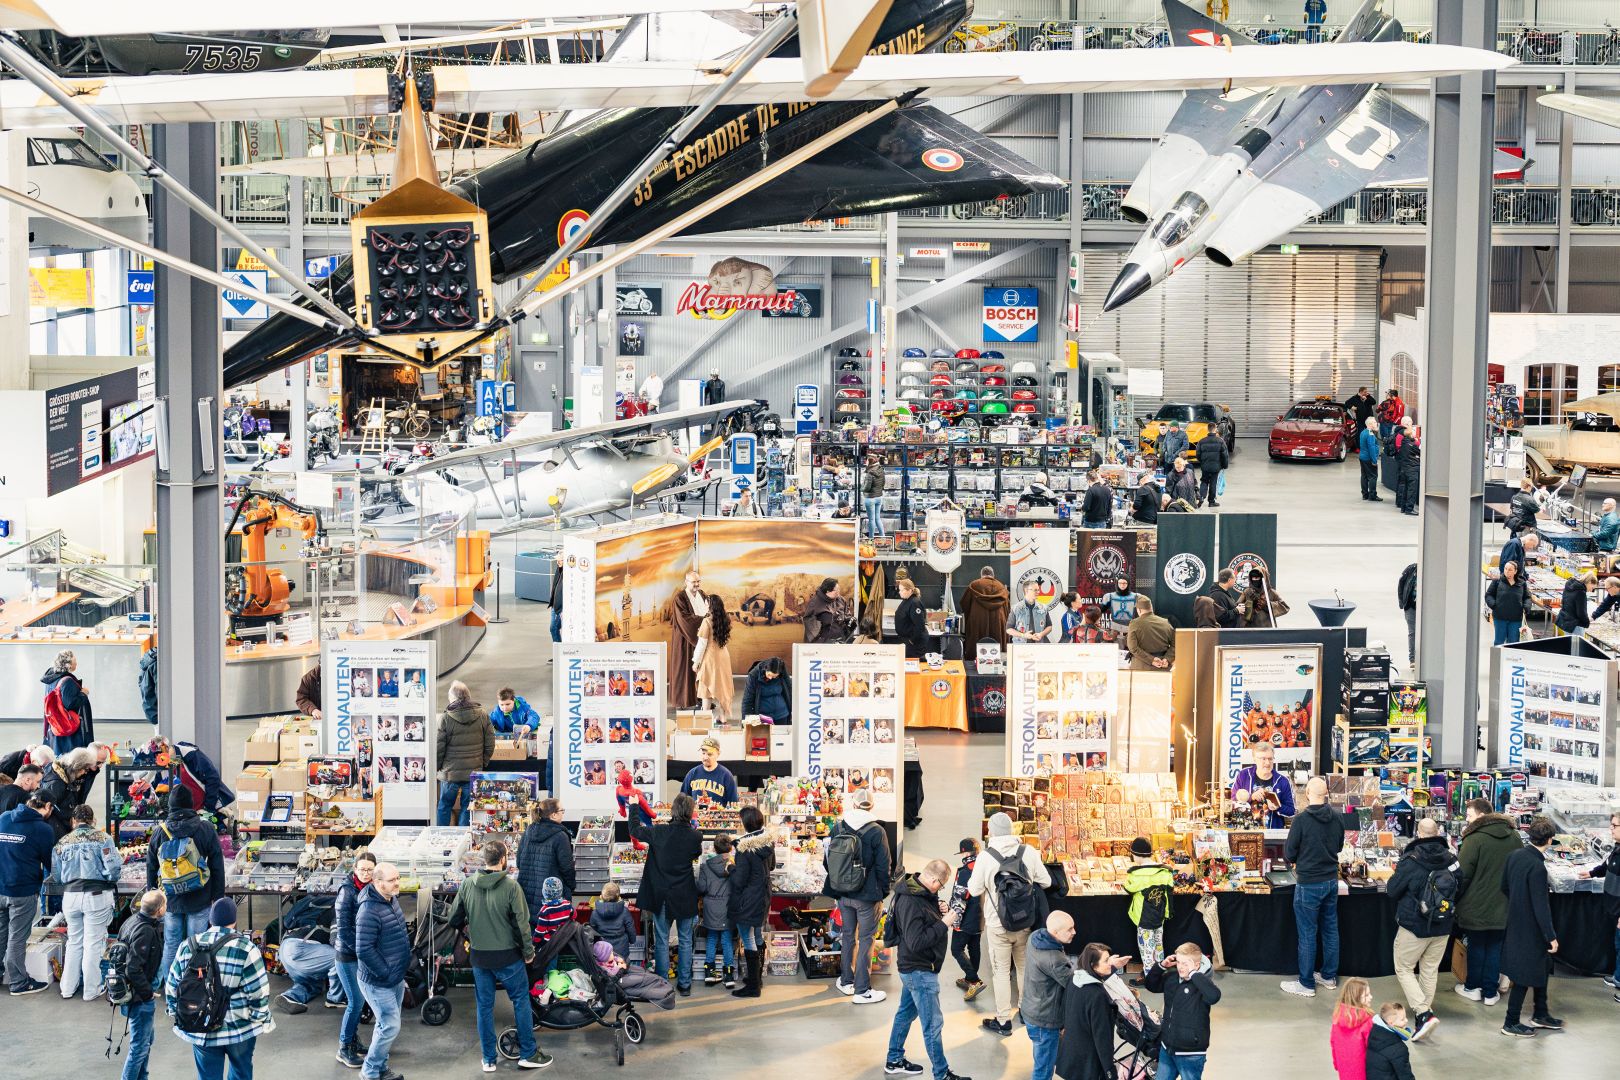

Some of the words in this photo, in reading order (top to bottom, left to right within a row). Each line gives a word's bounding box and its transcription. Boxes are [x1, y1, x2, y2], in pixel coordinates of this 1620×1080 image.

[182, 45, 263, 71] 7535
[671, 114, 751, 182] ESCADRE
[756, 101, 781, 133] DE
[676, 281, 797, 316] Mammut
[985, 308, 1037, 321] BOSCH
[49, 407, 58, 419] DER
[58, 404, 70, 416] WELT
[1019, 568, 1037, 585] REBEL
[1038, 568, 1061, 585] LEGION
[336, 656, 351, 753] RONAUTEN
[1022, 660, 1036, 776] STRONAUTEN
[1509, 665, 1525, 766] TRONAUTEN
[568, 658, 582, 788] ASTRONAUTEN
[171, 881, 190, 895] 192
